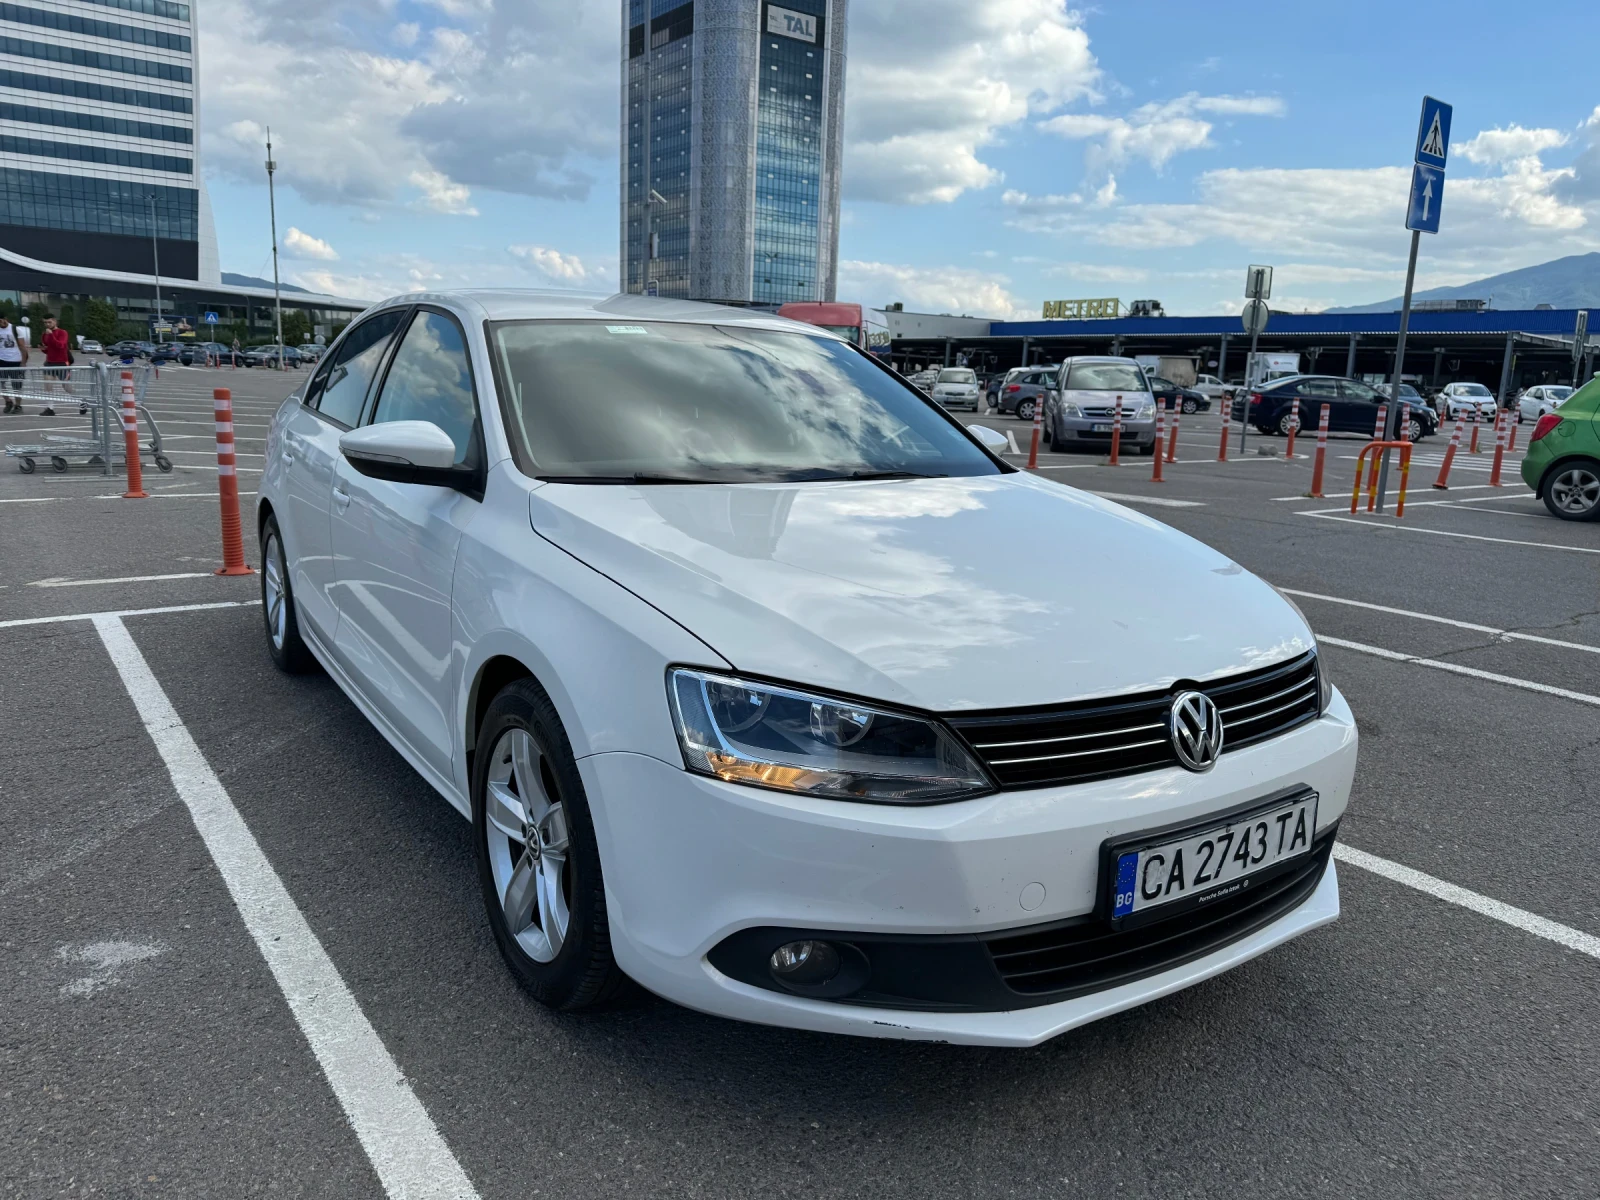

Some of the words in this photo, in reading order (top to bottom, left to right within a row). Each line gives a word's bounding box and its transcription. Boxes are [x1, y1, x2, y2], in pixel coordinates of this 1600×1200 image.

[783, 14, 814, 37] TAL
[1042, 298, 1119, 319] METRO
[1116, 893, 1133, 908] BG
[1141, 847, 1185, 900] CA
[1193, 821, 1268, 886] 2743
[1275, 807, 1307, 855] TA
